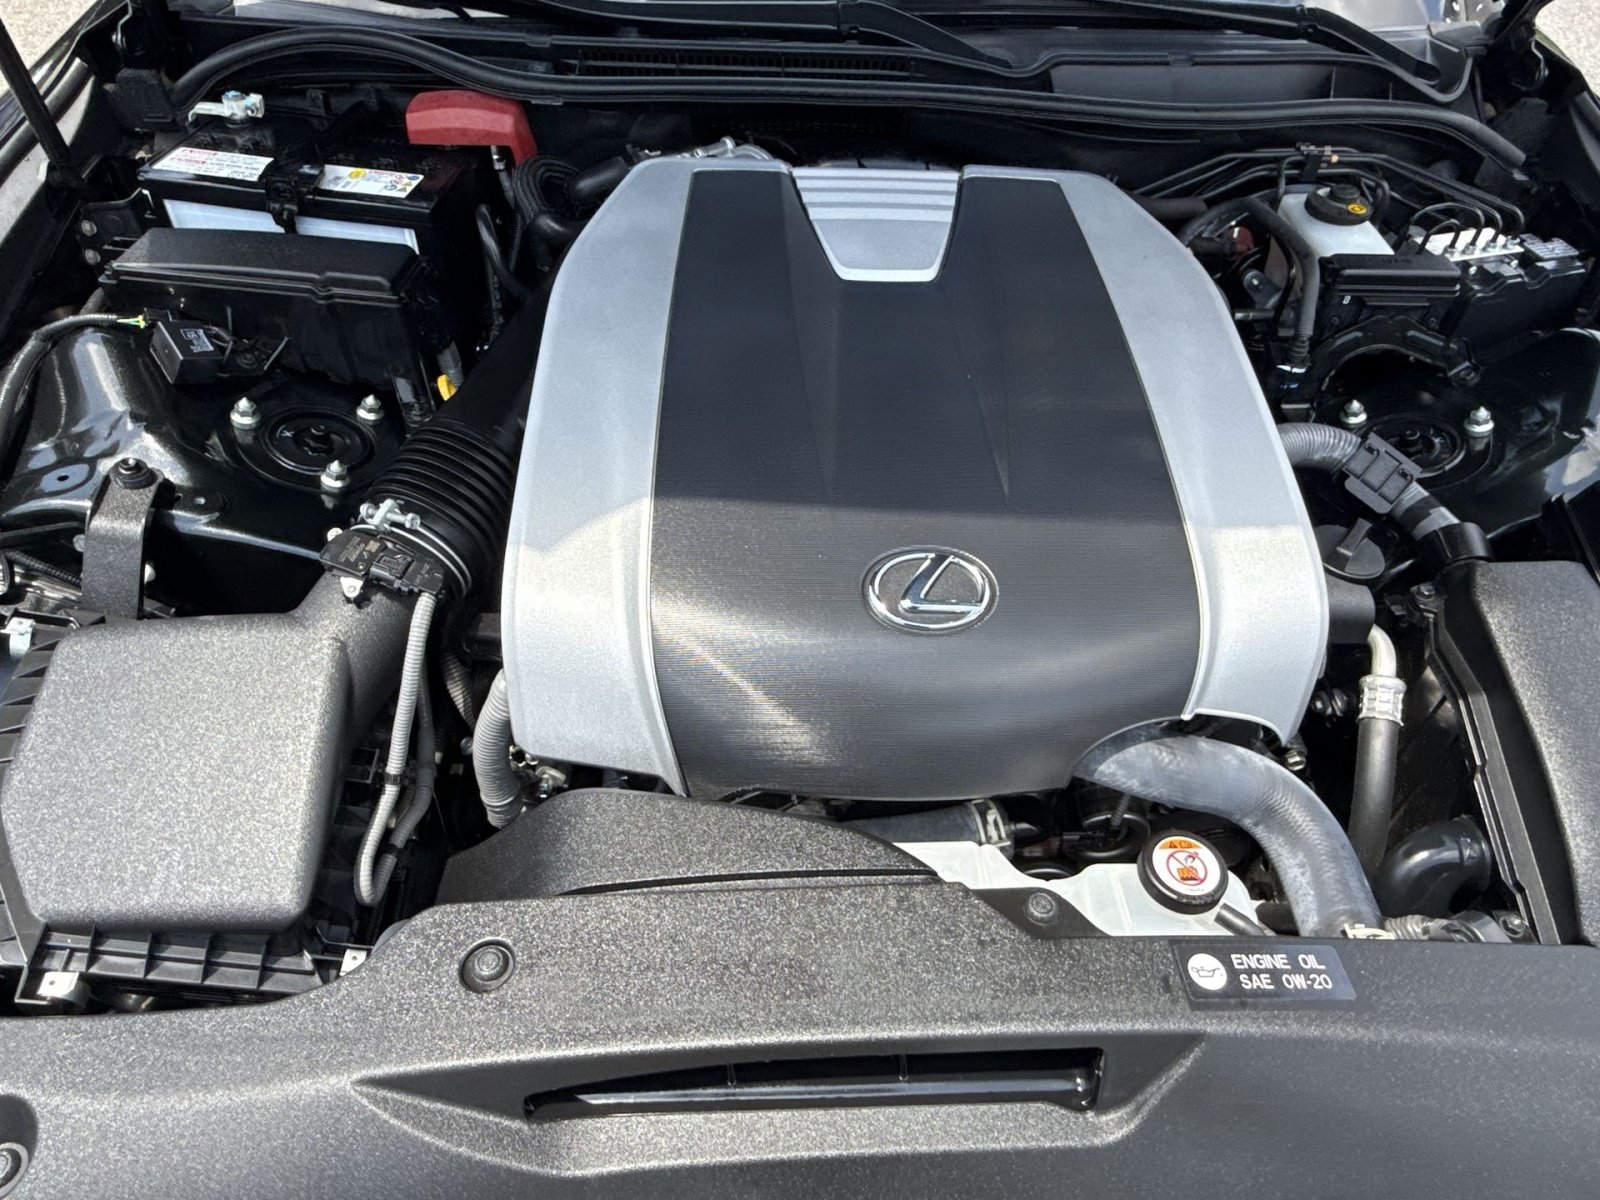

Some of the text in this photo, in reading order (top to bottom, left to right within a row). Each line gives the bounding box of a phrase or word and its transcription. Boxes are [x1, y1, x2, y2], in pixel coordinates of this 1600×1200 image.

[1230, 953, 1326, 970] ENGINE OIL
[1239, 973, 1333, 990] SAE 0W-20
